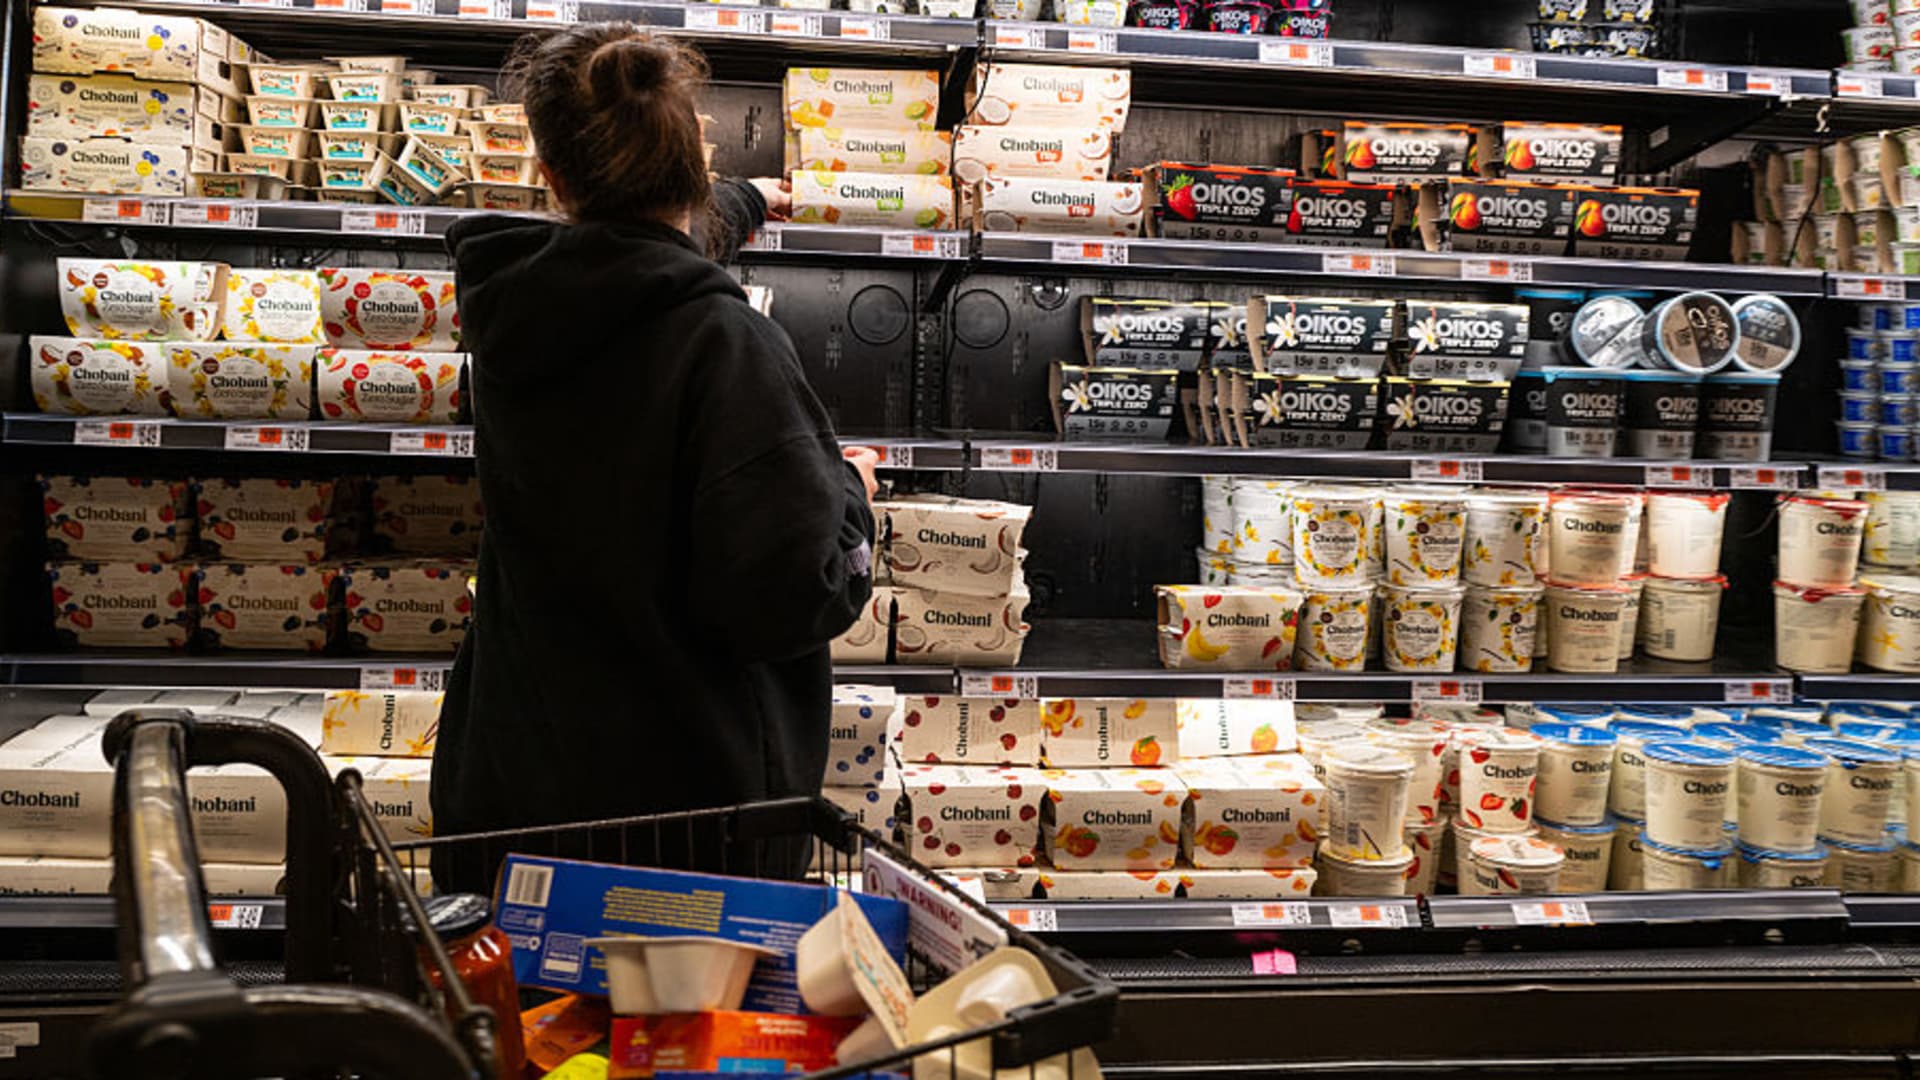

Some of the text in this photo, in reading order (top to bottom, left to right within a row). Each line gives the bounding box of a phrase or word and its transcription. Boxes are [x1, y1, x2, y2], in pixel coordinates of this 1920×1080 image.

[82, 24, 141, 40] Chobani
[833, 79, 893, 94] Chobani
[1023, 77, 1084, 92] Chobani
[79, 89, 138, 105] Chobani
[846, 140, 906, 154] Chobani
[1000, 139, 1063, 152] Chobani
[1371, 137, 1440, 158] OIKOS
[1529, 138, 1596, 159] OIKOS
[71, 151, 130, 167] Chobani
[840, 184, 904, 201] Chobani
[1031, 191, 1095, 207] Chobani
[1191, 182, 1265, 207] OIKOS
[1296, 197, 1367, 218] OIKOS
[1477, 197, 1547, 218] OIKOS
[1601, 204, 1671, 225] OIKOS
[100, 291, 153, 304] Chobani
[258, 299, 312, 311] Chobani
[362, 301, 419, 314] Chobani
[1120, 314, 1184, 333] OIKOS
[1296, 315, 1367, 335] OIKOS
[1436, 319, 1504, 339] OIKOS
[73, 368, 130, 383] Chobani
[211, 376, 268, 389] Chobani
[360, 382, 416, 394] Chobani
[1088, 382, 1153, 400] OIKOS
[1281, 391, 1351, 411] OIKOS
[1414, 396, 1482, 416] OIKOS
[1562, 393, 1617, 409] OIKOS
[1656, 396, 1697, 412] OIKO
[75, 505, 147, 523] Chobani
[227, 507, 296, 523] Chobani
[918, 529, 987, 549] Chobani
[83, 594, 157, 610] Chobani
[227, 595, 299, 612] Chobani
[375, 599, 444, 615] Chobani
[924, 610, 993, 627] Chobani
[1208, 613, 1270, 628] Chobani
[380, 694, 396, 750] Chobani
[957, 703, 969, 757] Chobani
[1098, 707, 1108, 760] Chobani
[0, 790, 80, 809] Chobani
[192, 796, 256, 813] hobani
[374, 800, 413, 817] bani
[941, 806, 1011, 821] Chobani
[1084, 809, 1152, 825] Chobani
[1222, 807, 1290, 823] Chobani
[896, 877, 963, 933] WARNING!
